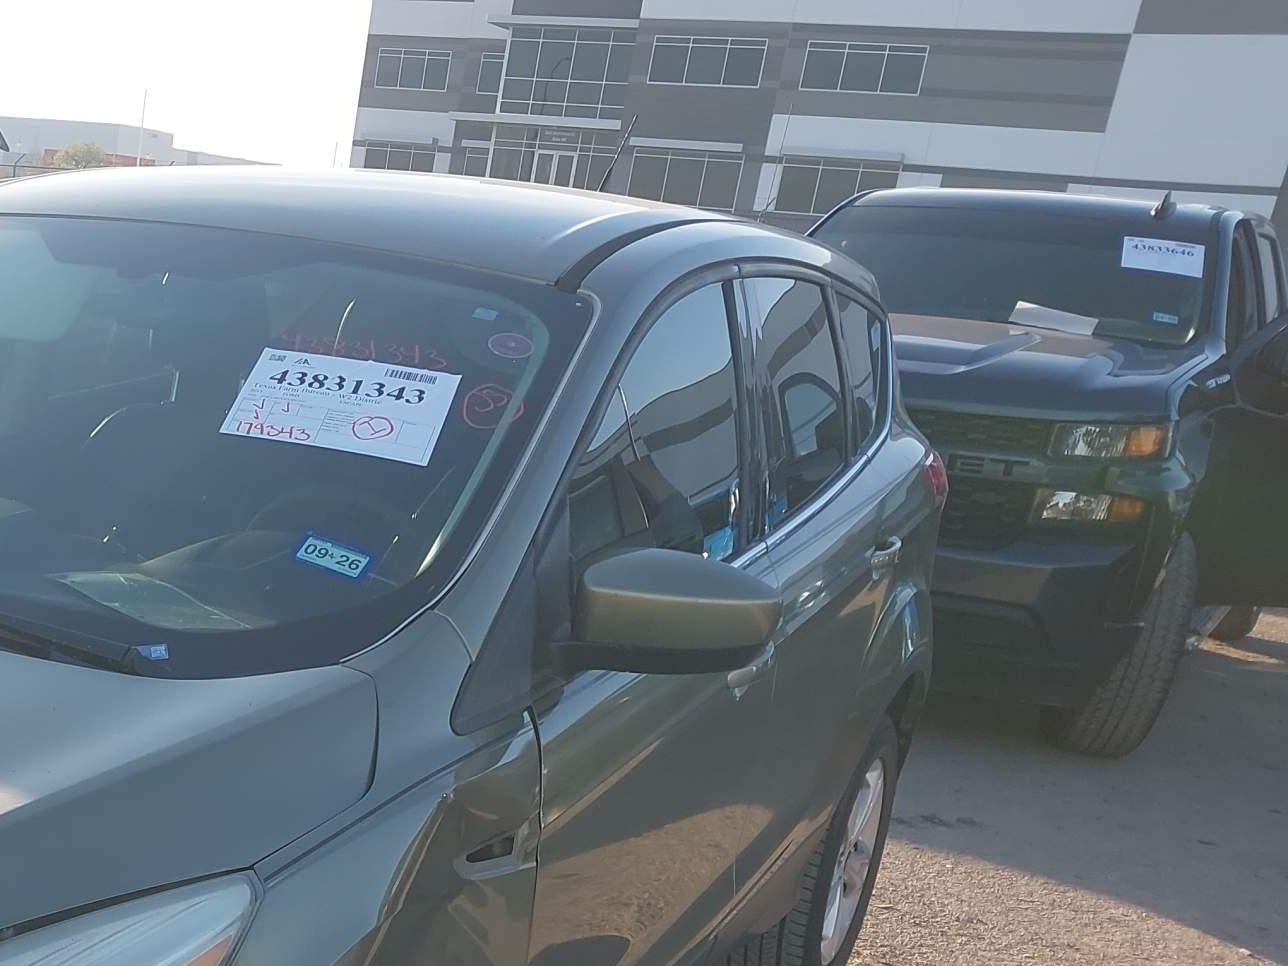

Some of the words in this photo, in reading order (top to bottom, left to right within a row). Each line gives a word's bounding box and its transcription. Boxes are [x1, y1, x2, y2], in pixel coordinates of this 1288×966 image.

[269, 369, 426, 405] 43831343
[236, 420, 311, 441] 179343
[335, 554, 362, 571] 26
